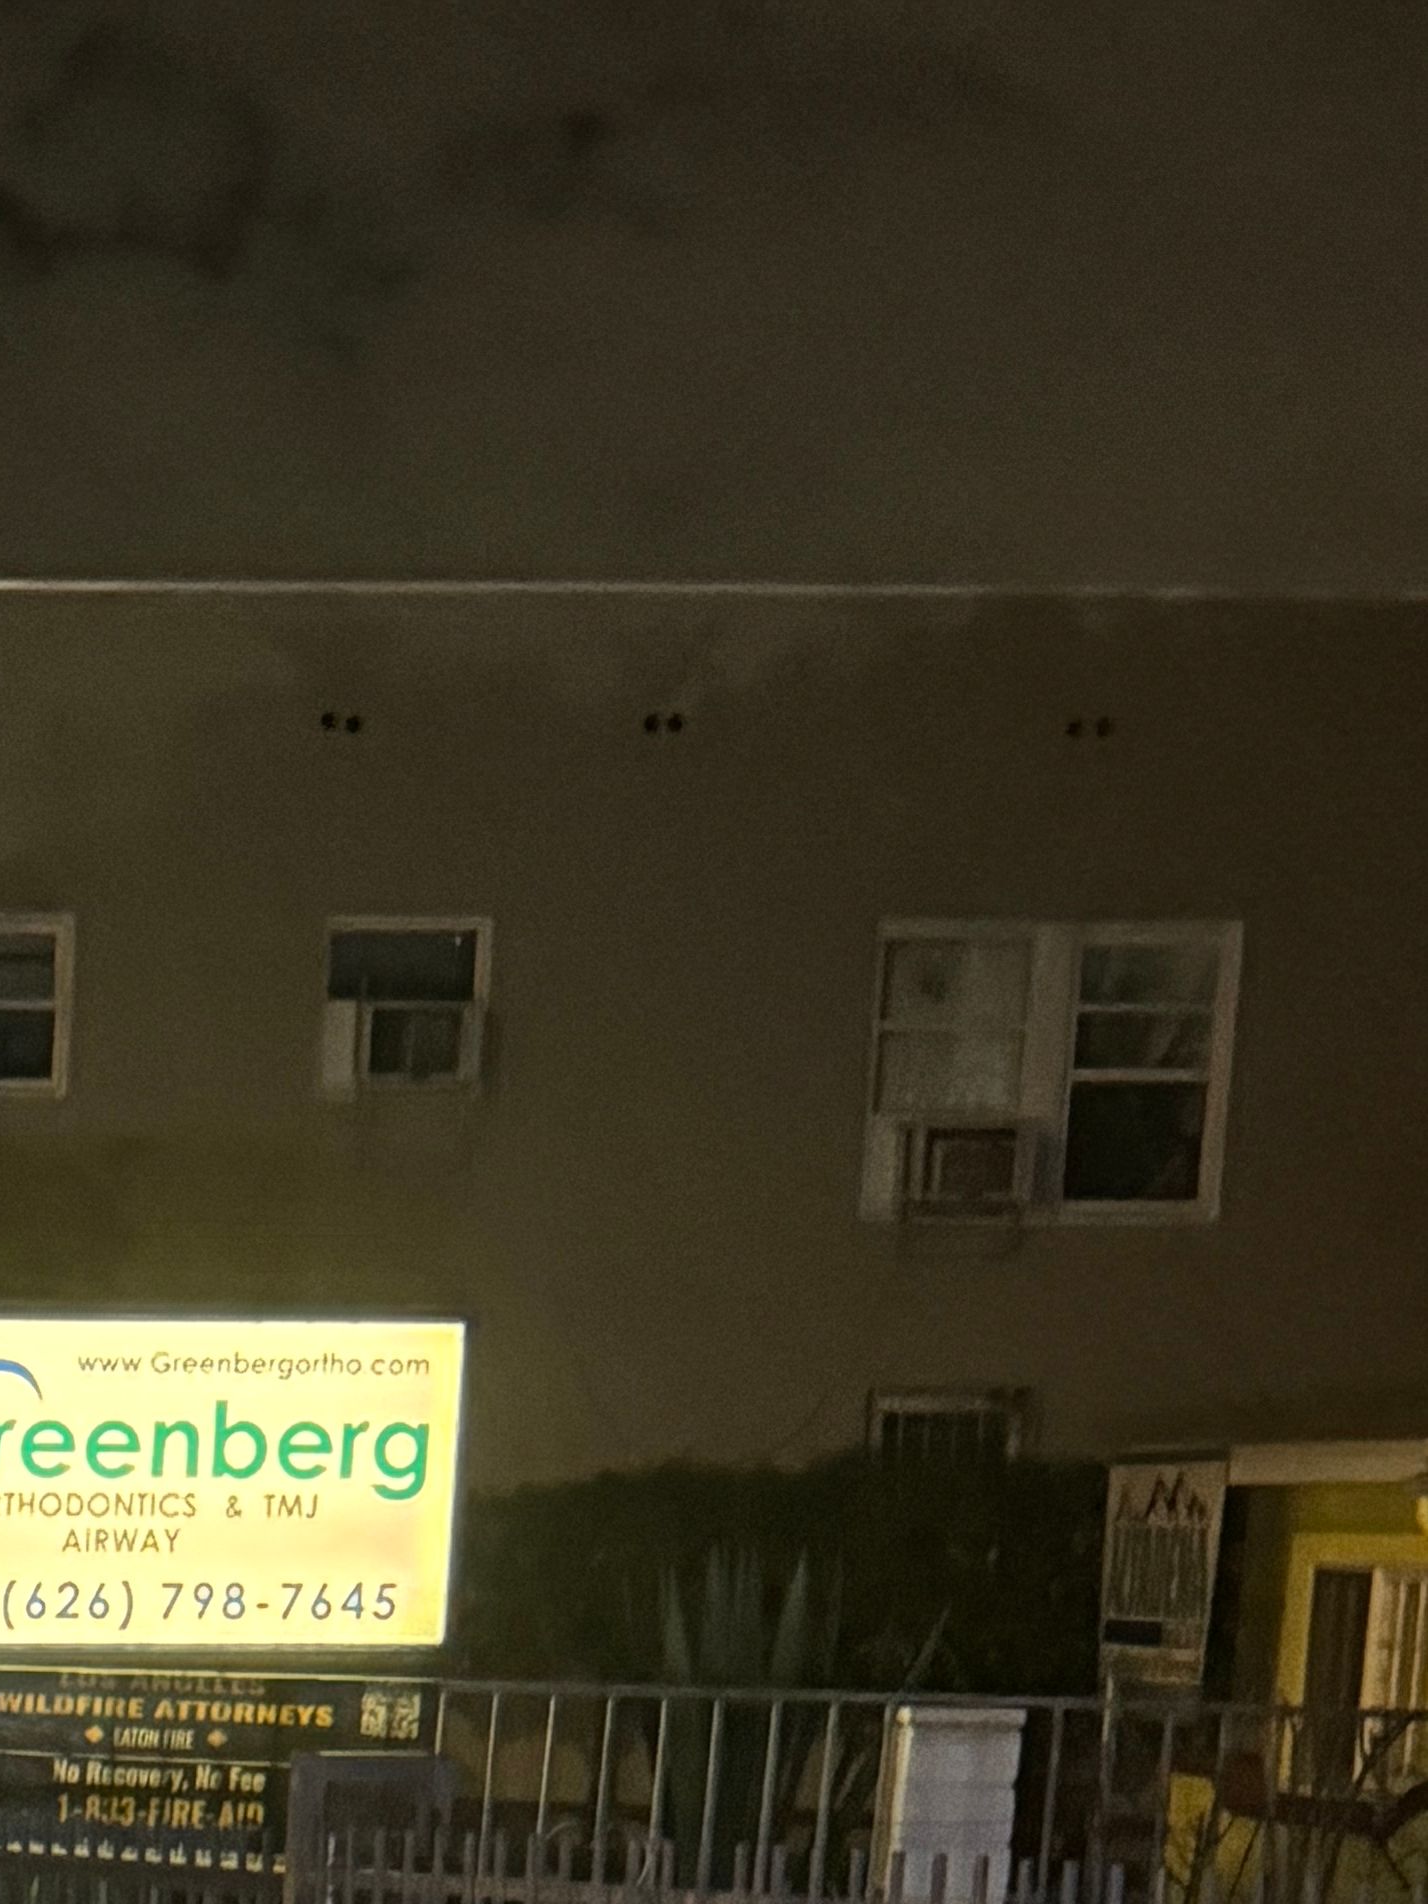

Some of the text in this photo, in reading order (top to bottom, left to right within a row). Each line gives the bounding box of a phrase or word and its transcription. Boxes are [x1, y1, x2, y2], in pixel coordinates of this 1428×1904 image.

[225, 1495, 242, 1518] &
[264, 1493, 319, 1519] TMJ
[61, 1528, 181, 1553] AIRWAY
[2, 1579, 398, 1630] (626) 798-7645
[153, 1699, 335, 1728] ATTORNEYS
[162, 1729, 196, 1750] FIRE
[52, 1758, 81, 1785] No
[194, 1763, 223, 1792] No
[229, 1766, 266, 1793] Fee
